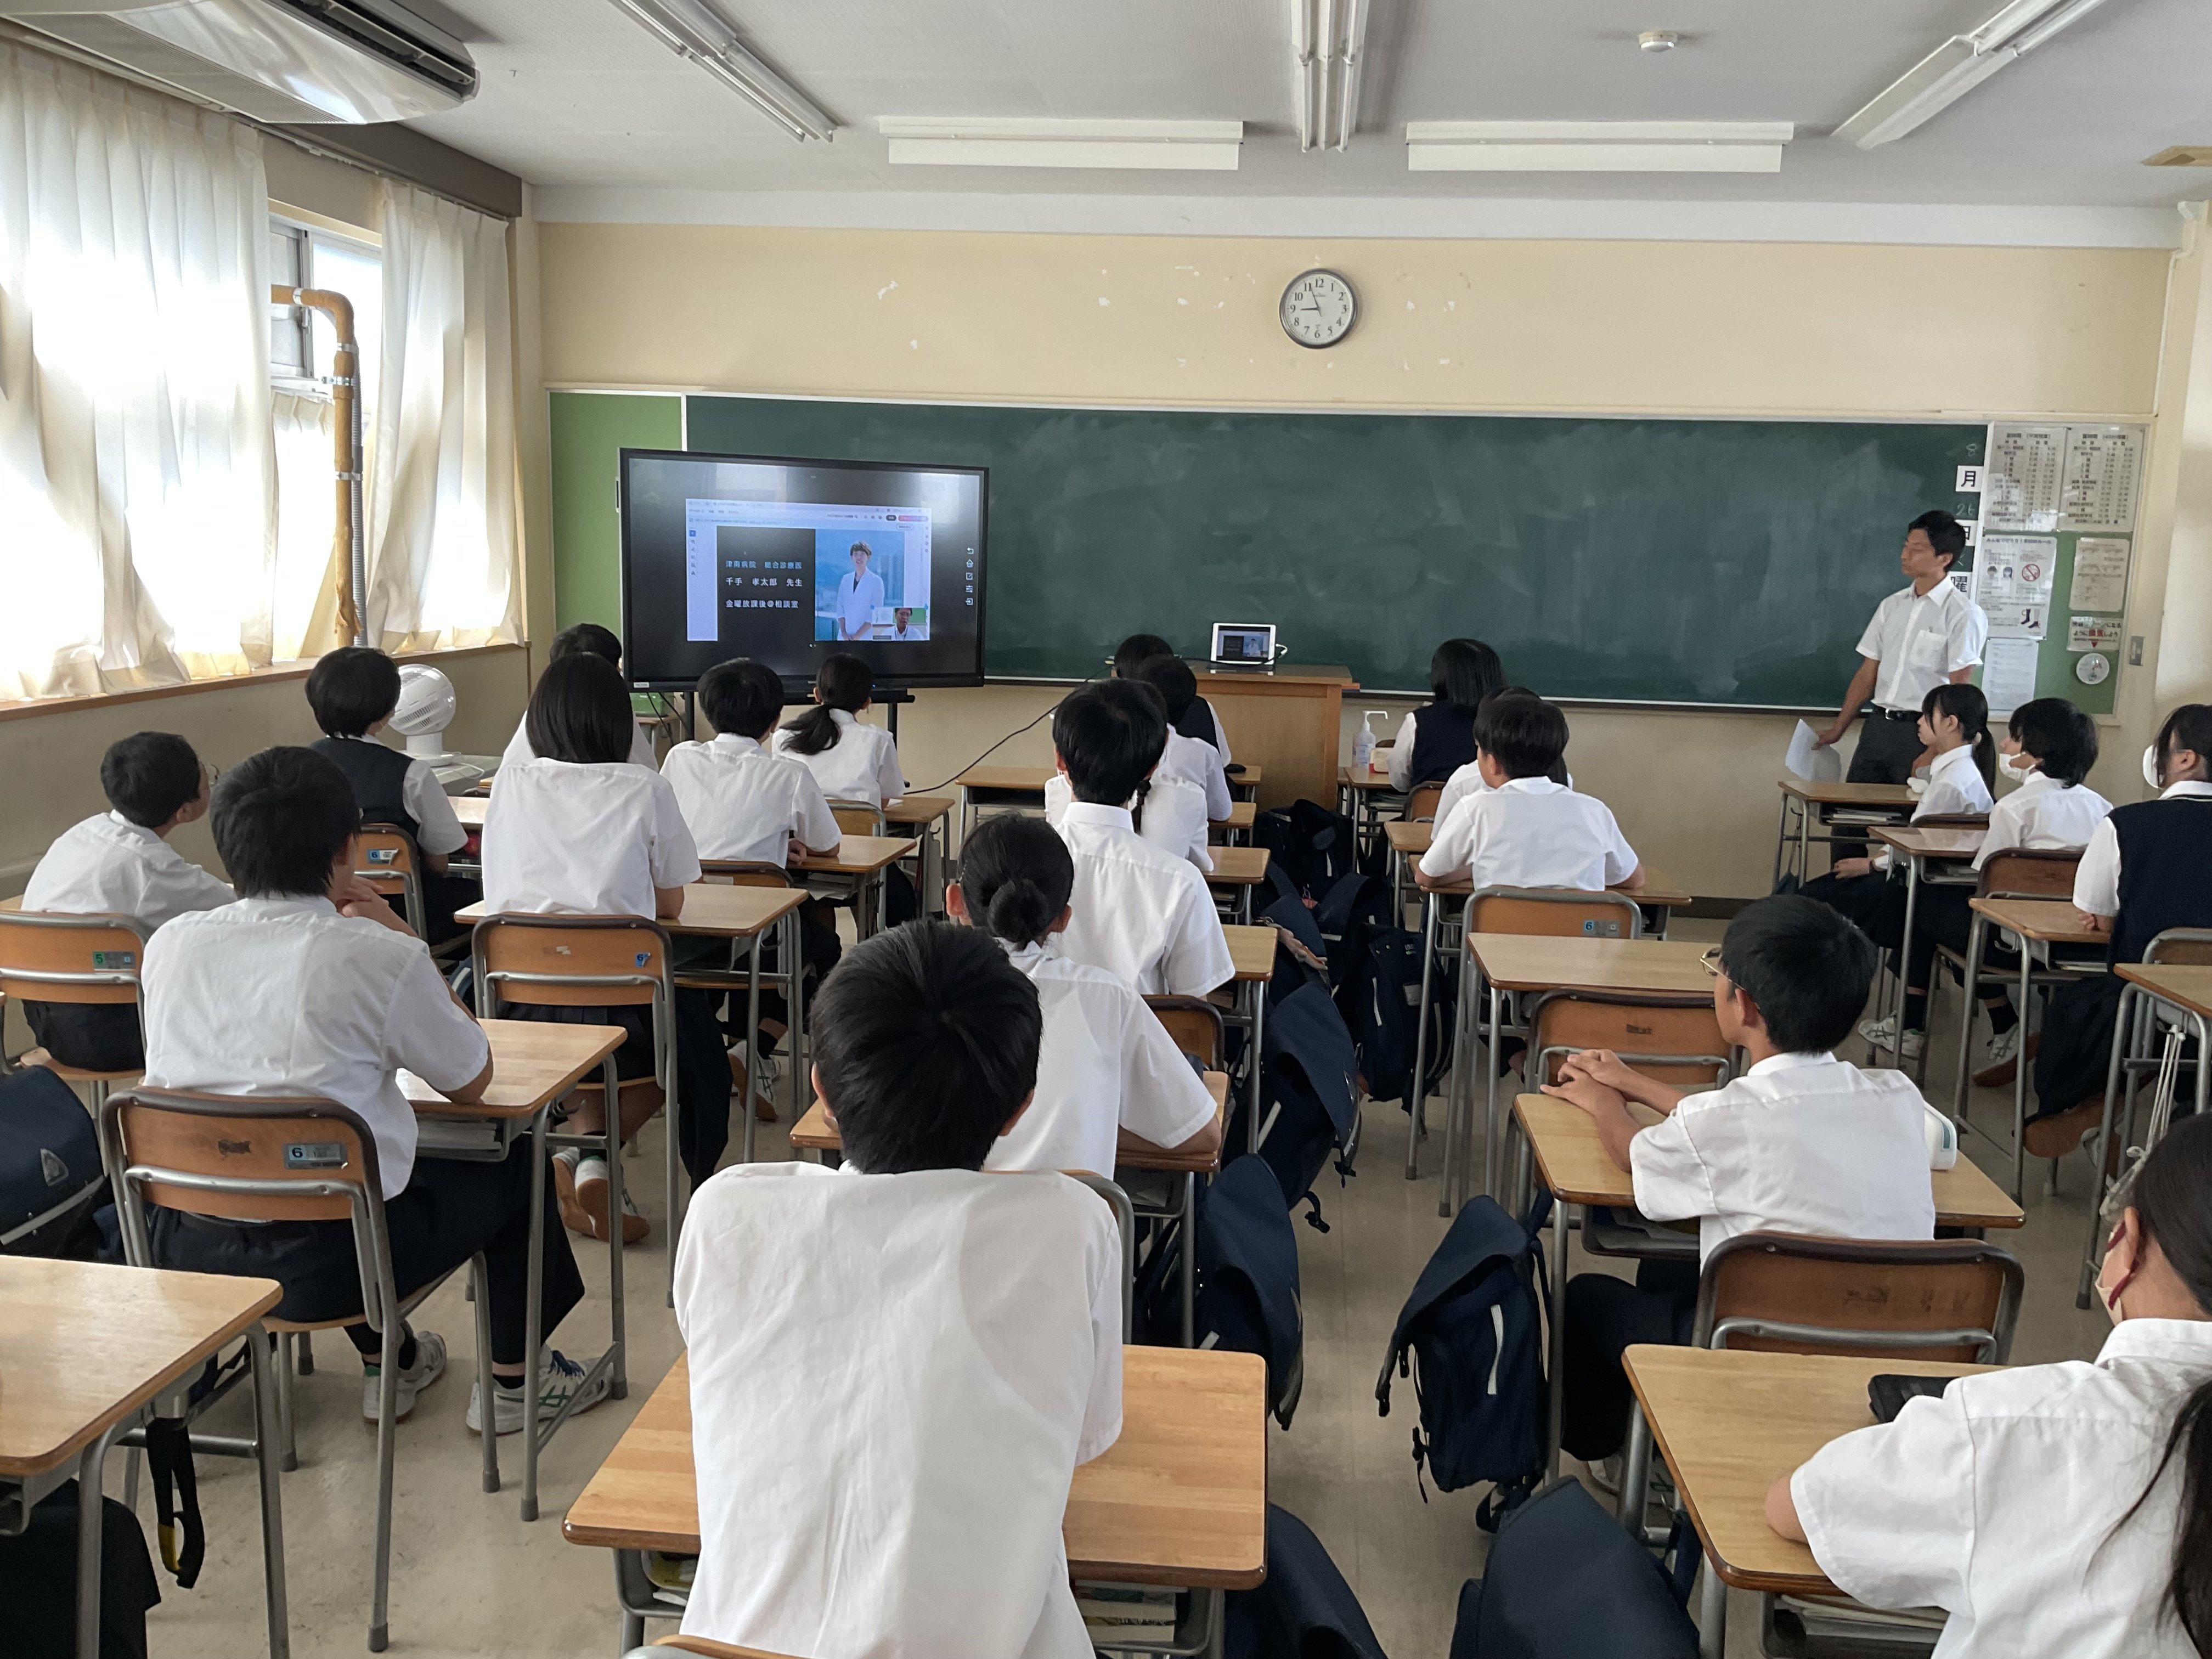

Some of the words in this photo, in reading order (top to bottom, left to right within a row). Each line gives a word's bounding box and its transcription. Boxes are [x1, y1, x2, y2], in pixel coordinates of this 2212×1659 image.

[1315, 278, 1324, 287] 12
[1304, 283, 1312, 292] 11
[1330, 283, 1334, 292] 1
[1294, 292, 1303, 301] 10
[1338, 292, 1344, 301] 2
[1290, 304, 1296, 314] 9
[1341, 304, 1347, 314] 3
[1294, 317, 1300, 326] 8
[1336, 317, 1342, 326] 4
[1304, 326, 1310, 335] 7
[1314, 330, 1321, 338] 6
[1327, 326, 1333, 336] 5
[1961, 470, 1976, 487] 月
[725, 577, 743, 586] 千手
[786, 578, 803, 587] 先生
[1585, 922, 1593, 930] 6
[95, 953, 104, 964] 5
[292, 1147, 304, 1158] 6
